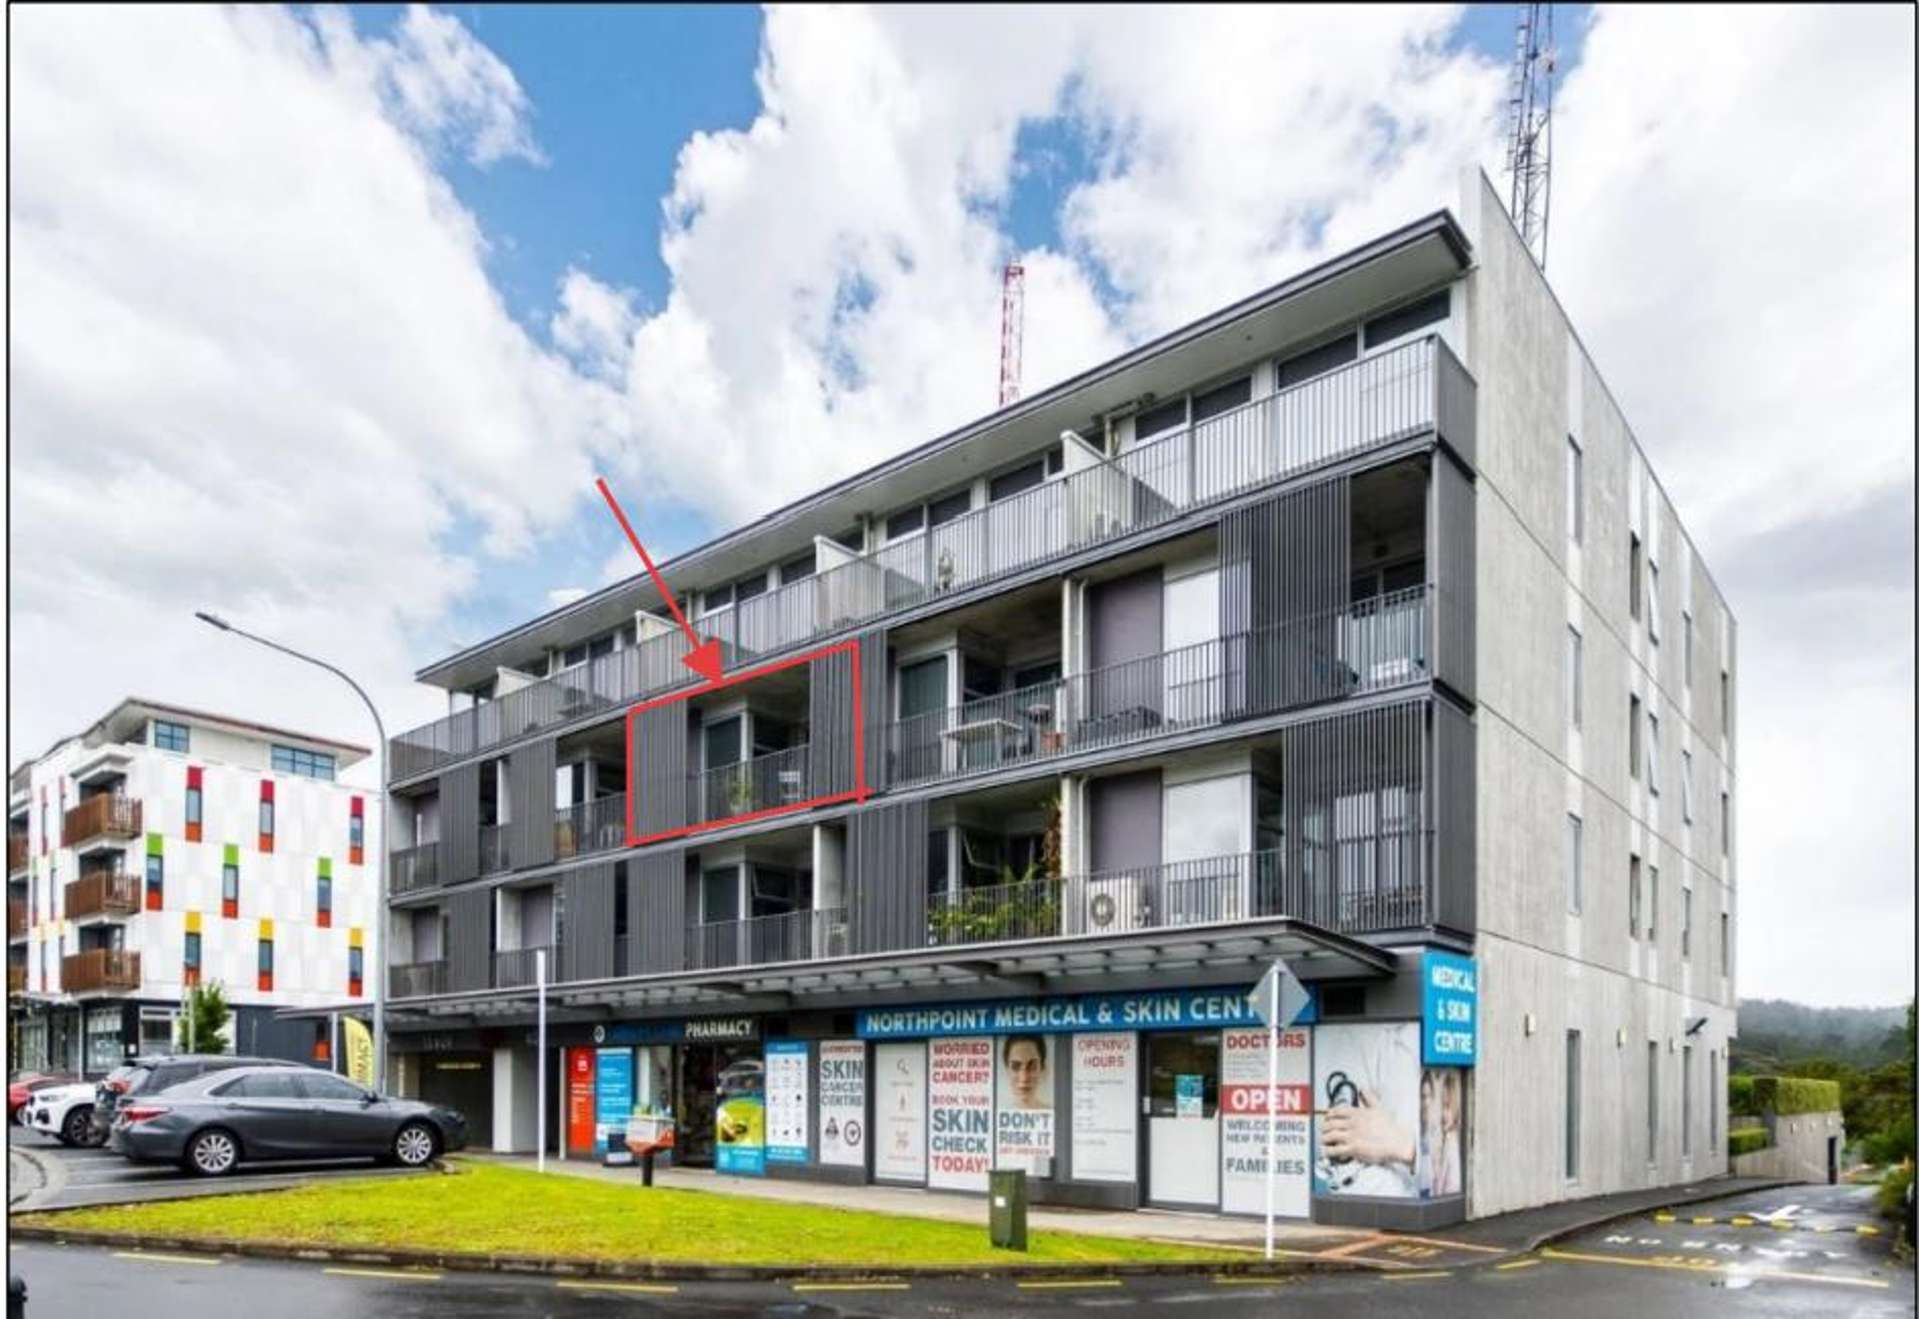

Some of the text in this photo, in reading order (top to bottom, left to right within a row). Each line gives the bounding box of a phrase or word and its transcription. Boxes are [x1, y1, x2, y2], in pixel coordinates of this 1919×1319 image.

[1432, 965, 1474, 993] MEDICAL
[866, 996, 1256, 1032] NORTHPOINT MEDICAL & SKIN CENT
[1447, 1000, 1471, 1022] SKIN
[685, 1020, 752, 1039] PHARMACY
[934, 1042, 990, 1055] WORRIED
[1078, 1039, 1130, 1051] OPENING
[1435, 1030, 1473, 1055] CENTRE
[821, 1059, 864, 1079] SKIN
[932, 1058, 990, 1069] ABOUT SKIN
[1083, 1055, 1125, 1068] HOURS
[931, 1095, 990, 1107] BOOK YOUR
[1231, 1088, 1301, 1110] OPEN
[931, 1108, 990, 1134] SKIN
[999, 1112, 1051, 1129] DON'T
[931, 1136, 988, 1152] CHECK
[999, 1130, 1051, 1146] RISK IT
[1226, 1157, 1306, 1175] FAMIIES
